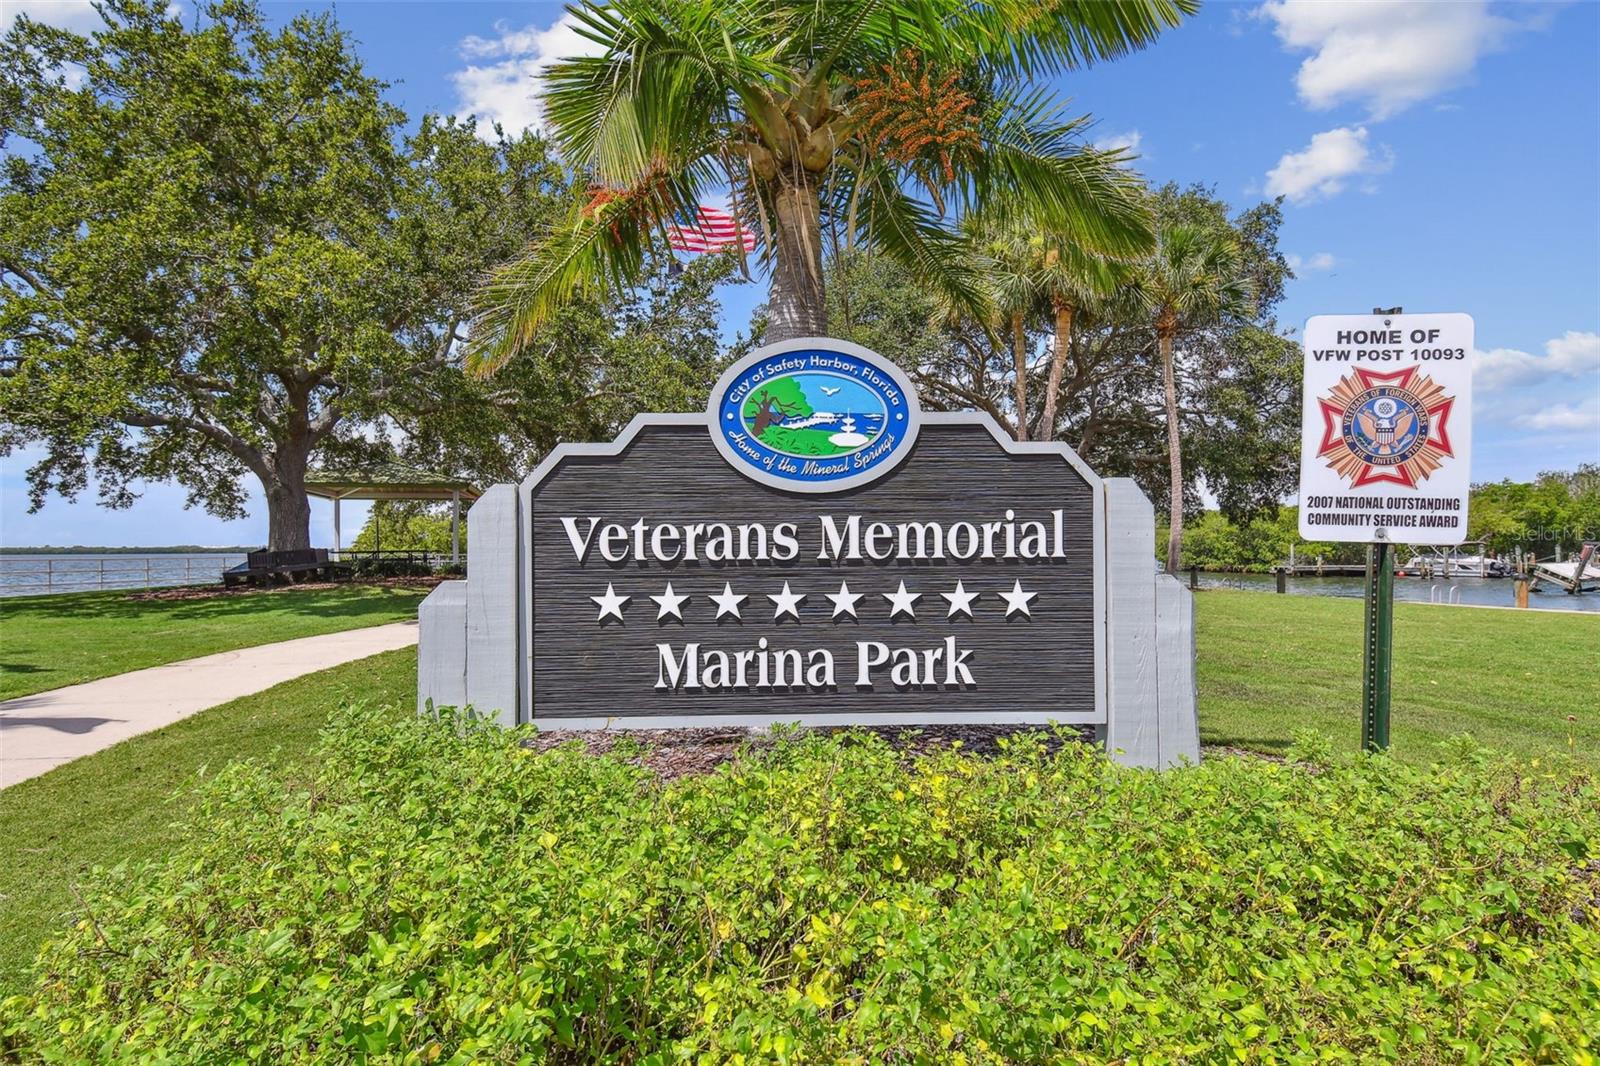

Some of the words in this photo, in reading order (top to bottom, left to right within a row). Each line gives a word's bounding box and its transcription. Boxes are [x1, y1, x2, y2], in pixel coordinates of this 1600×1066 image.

[1337, 330, 1402, 345] HOME
[1410, 329, 1440, 343] OF
[1313, 350, 1351, 361] VFW
[1357, 350, 1403, 361] POST
[1411, 348, 1465, 360] 10093
[730, 380, 751, 404] City
[753, 368, 765, 382] of
[766, 358, 806, 375] Safety
[810, 356, 858, 375] Harbor,
[862, 367, 899, 407] Florida
[1344, 393, 1370, 426] VETERANS
[1371, 389, 1380, 397] OF
[1385, 390, 1421, 409] FOREIGN
[1416, 404, 1427, 426] WARS
[728, 430, 761, 461] Home
[763, 453, 777, 470] of
[778, 457, 797, 474] the
[801, 456, 850, 476] Mineral
[854, 433, 895, 469] Springs
[1345, 435, 1353, 445] OF
[1353, 447, 1366, 460] THE
[1372, 456, 1401, 464] UNITED
[1407, 435, 1426, 458] STATES
[1307, 496, 1334, 509] 2007
[1335, 497, 1384, 509] NATIONAL
[1386, 497, 1460, 511] OUTSTANDING
[561, 517, 799, 563] Veterans
[817, 509, 1066, 561] Memorial
[1307, 514, 1372, 526] COMMUNITY
[1373, 515, 1418, 527] SERVICE
[1419, 516, 1458, 528] AWARD
[654, 637, 837, 689] Marina
[855, 635, 977, 687] Park
